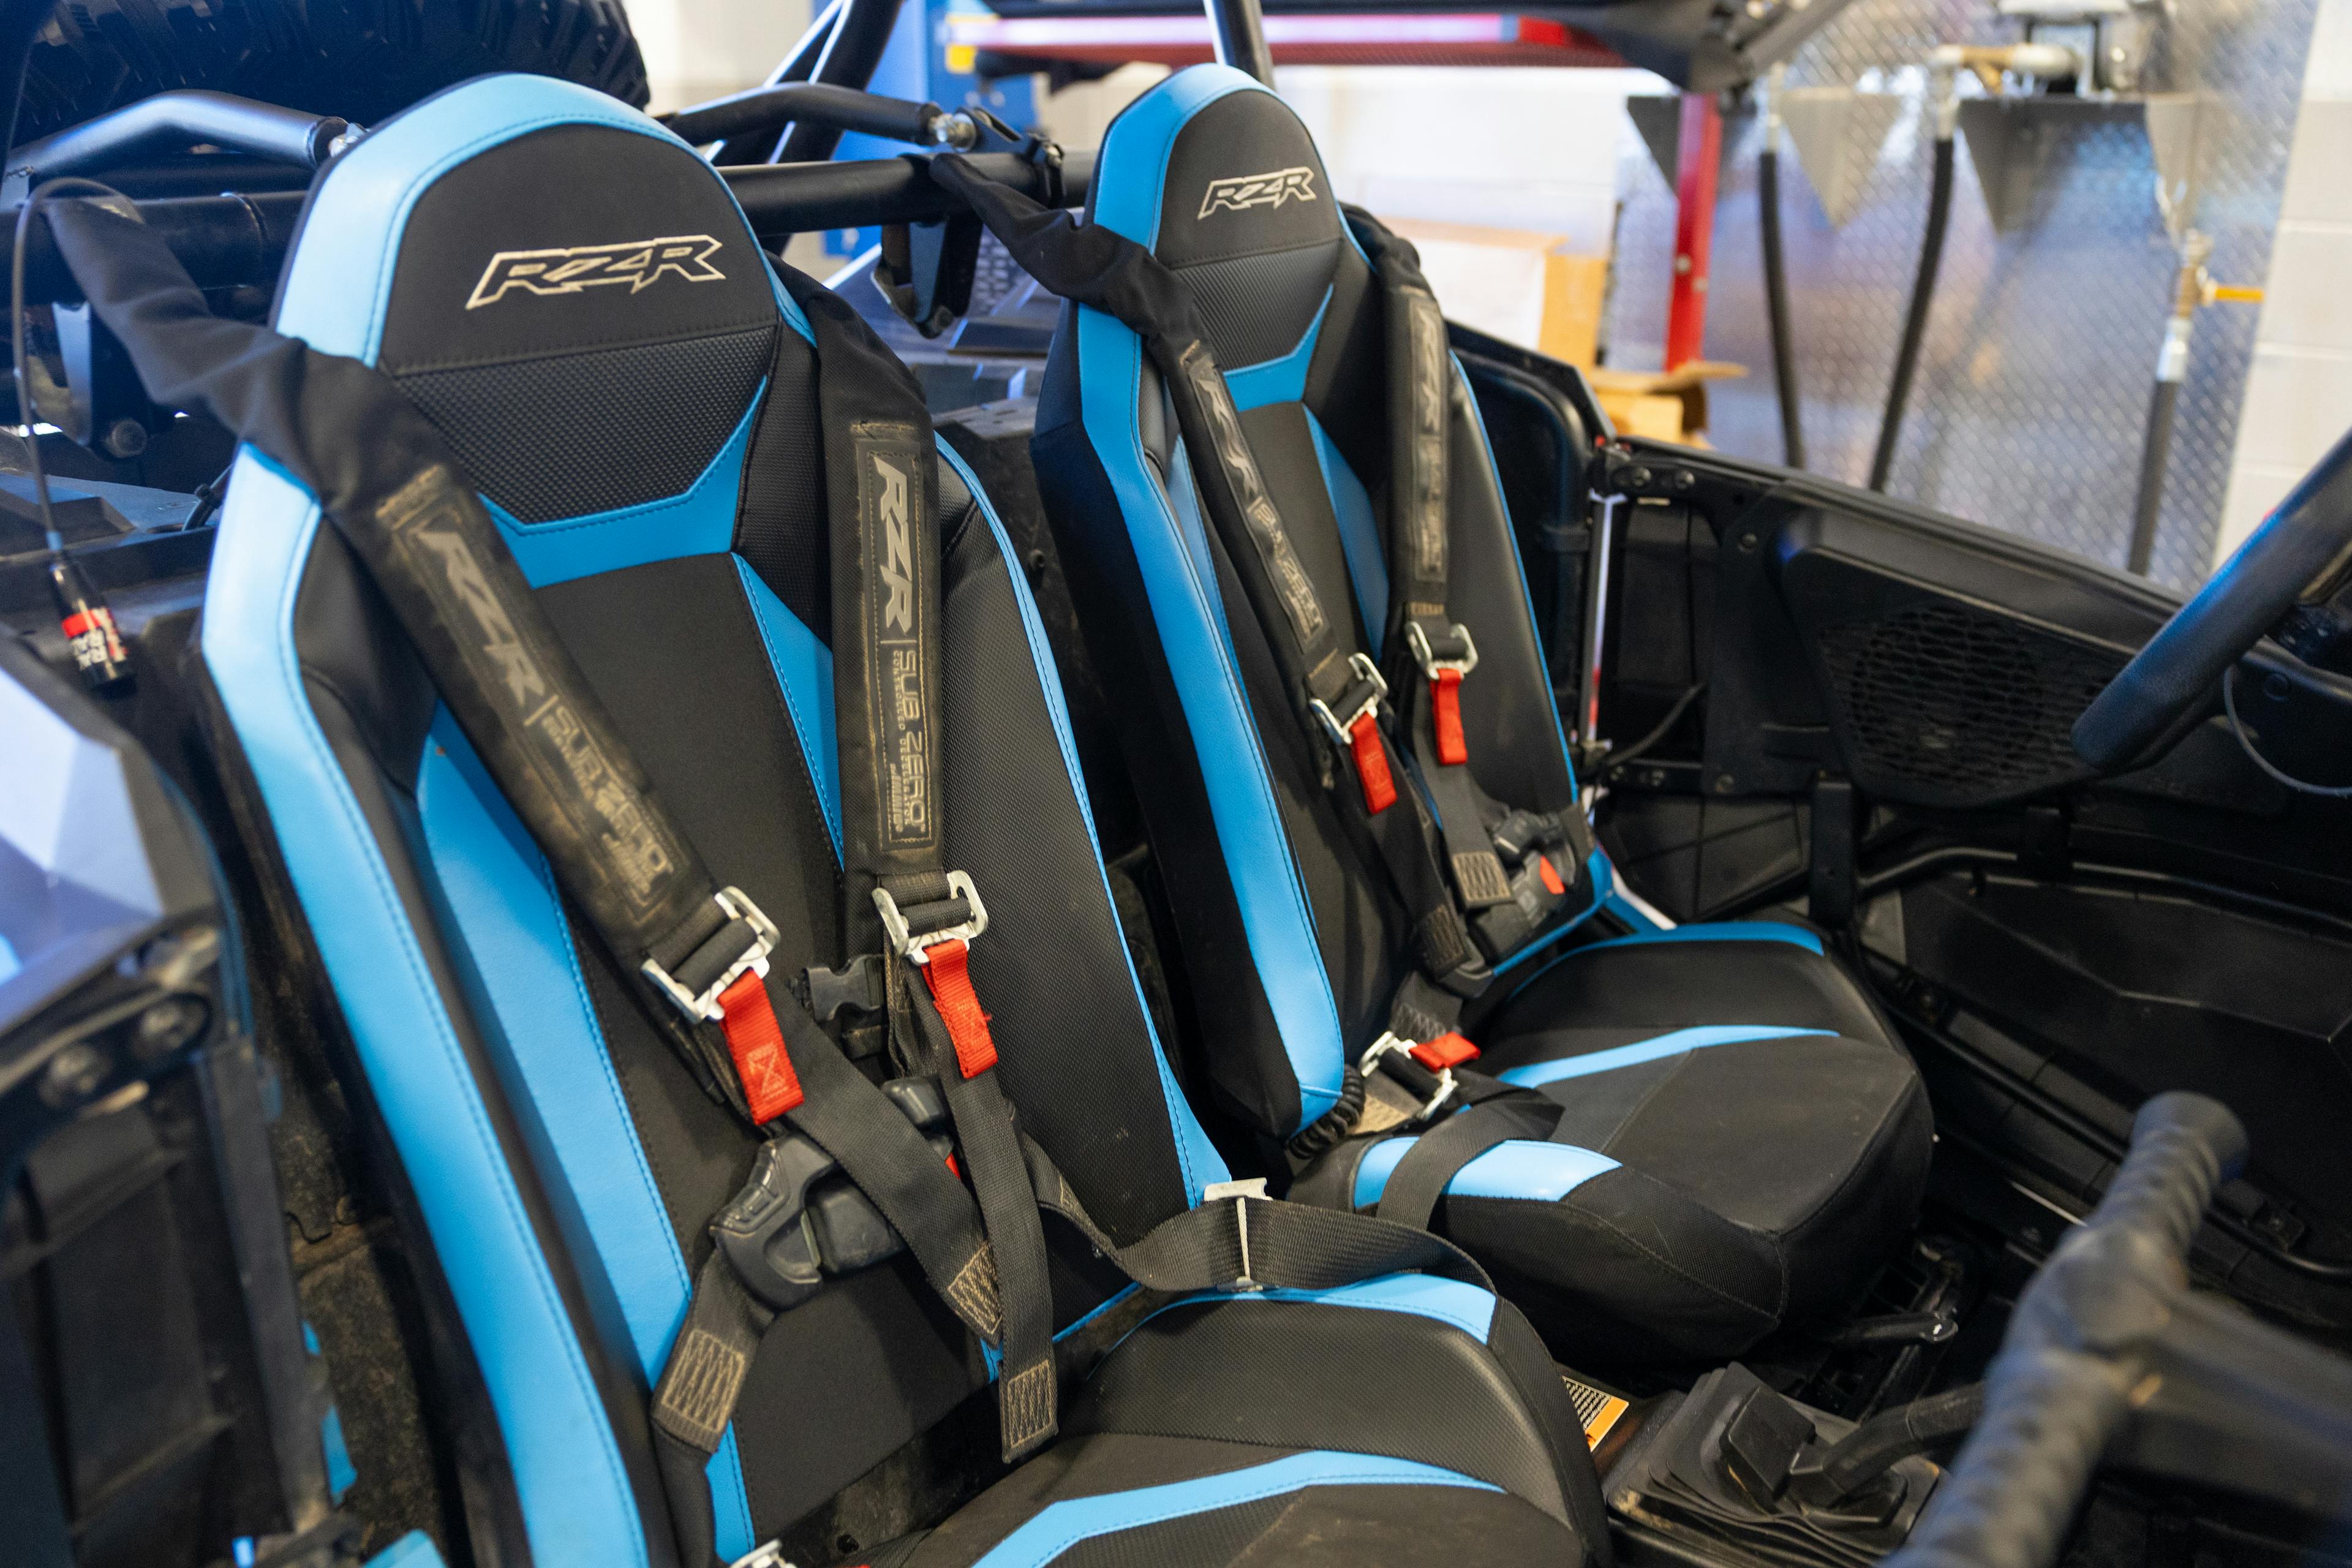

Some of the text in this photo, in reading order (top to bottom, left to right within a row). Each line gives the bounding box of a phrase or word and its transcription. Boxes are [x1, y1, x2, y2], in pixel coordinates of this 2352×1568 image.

[1196, 166, 1317, 221] RZR
[466, 235, 726, 310] RZR
[874, 456, 925, 826] RZR SUB ZERO
[549, 706, 603, 782] SUB
[892, 649, 912, 825] CONTROLLED DECELERATOR
